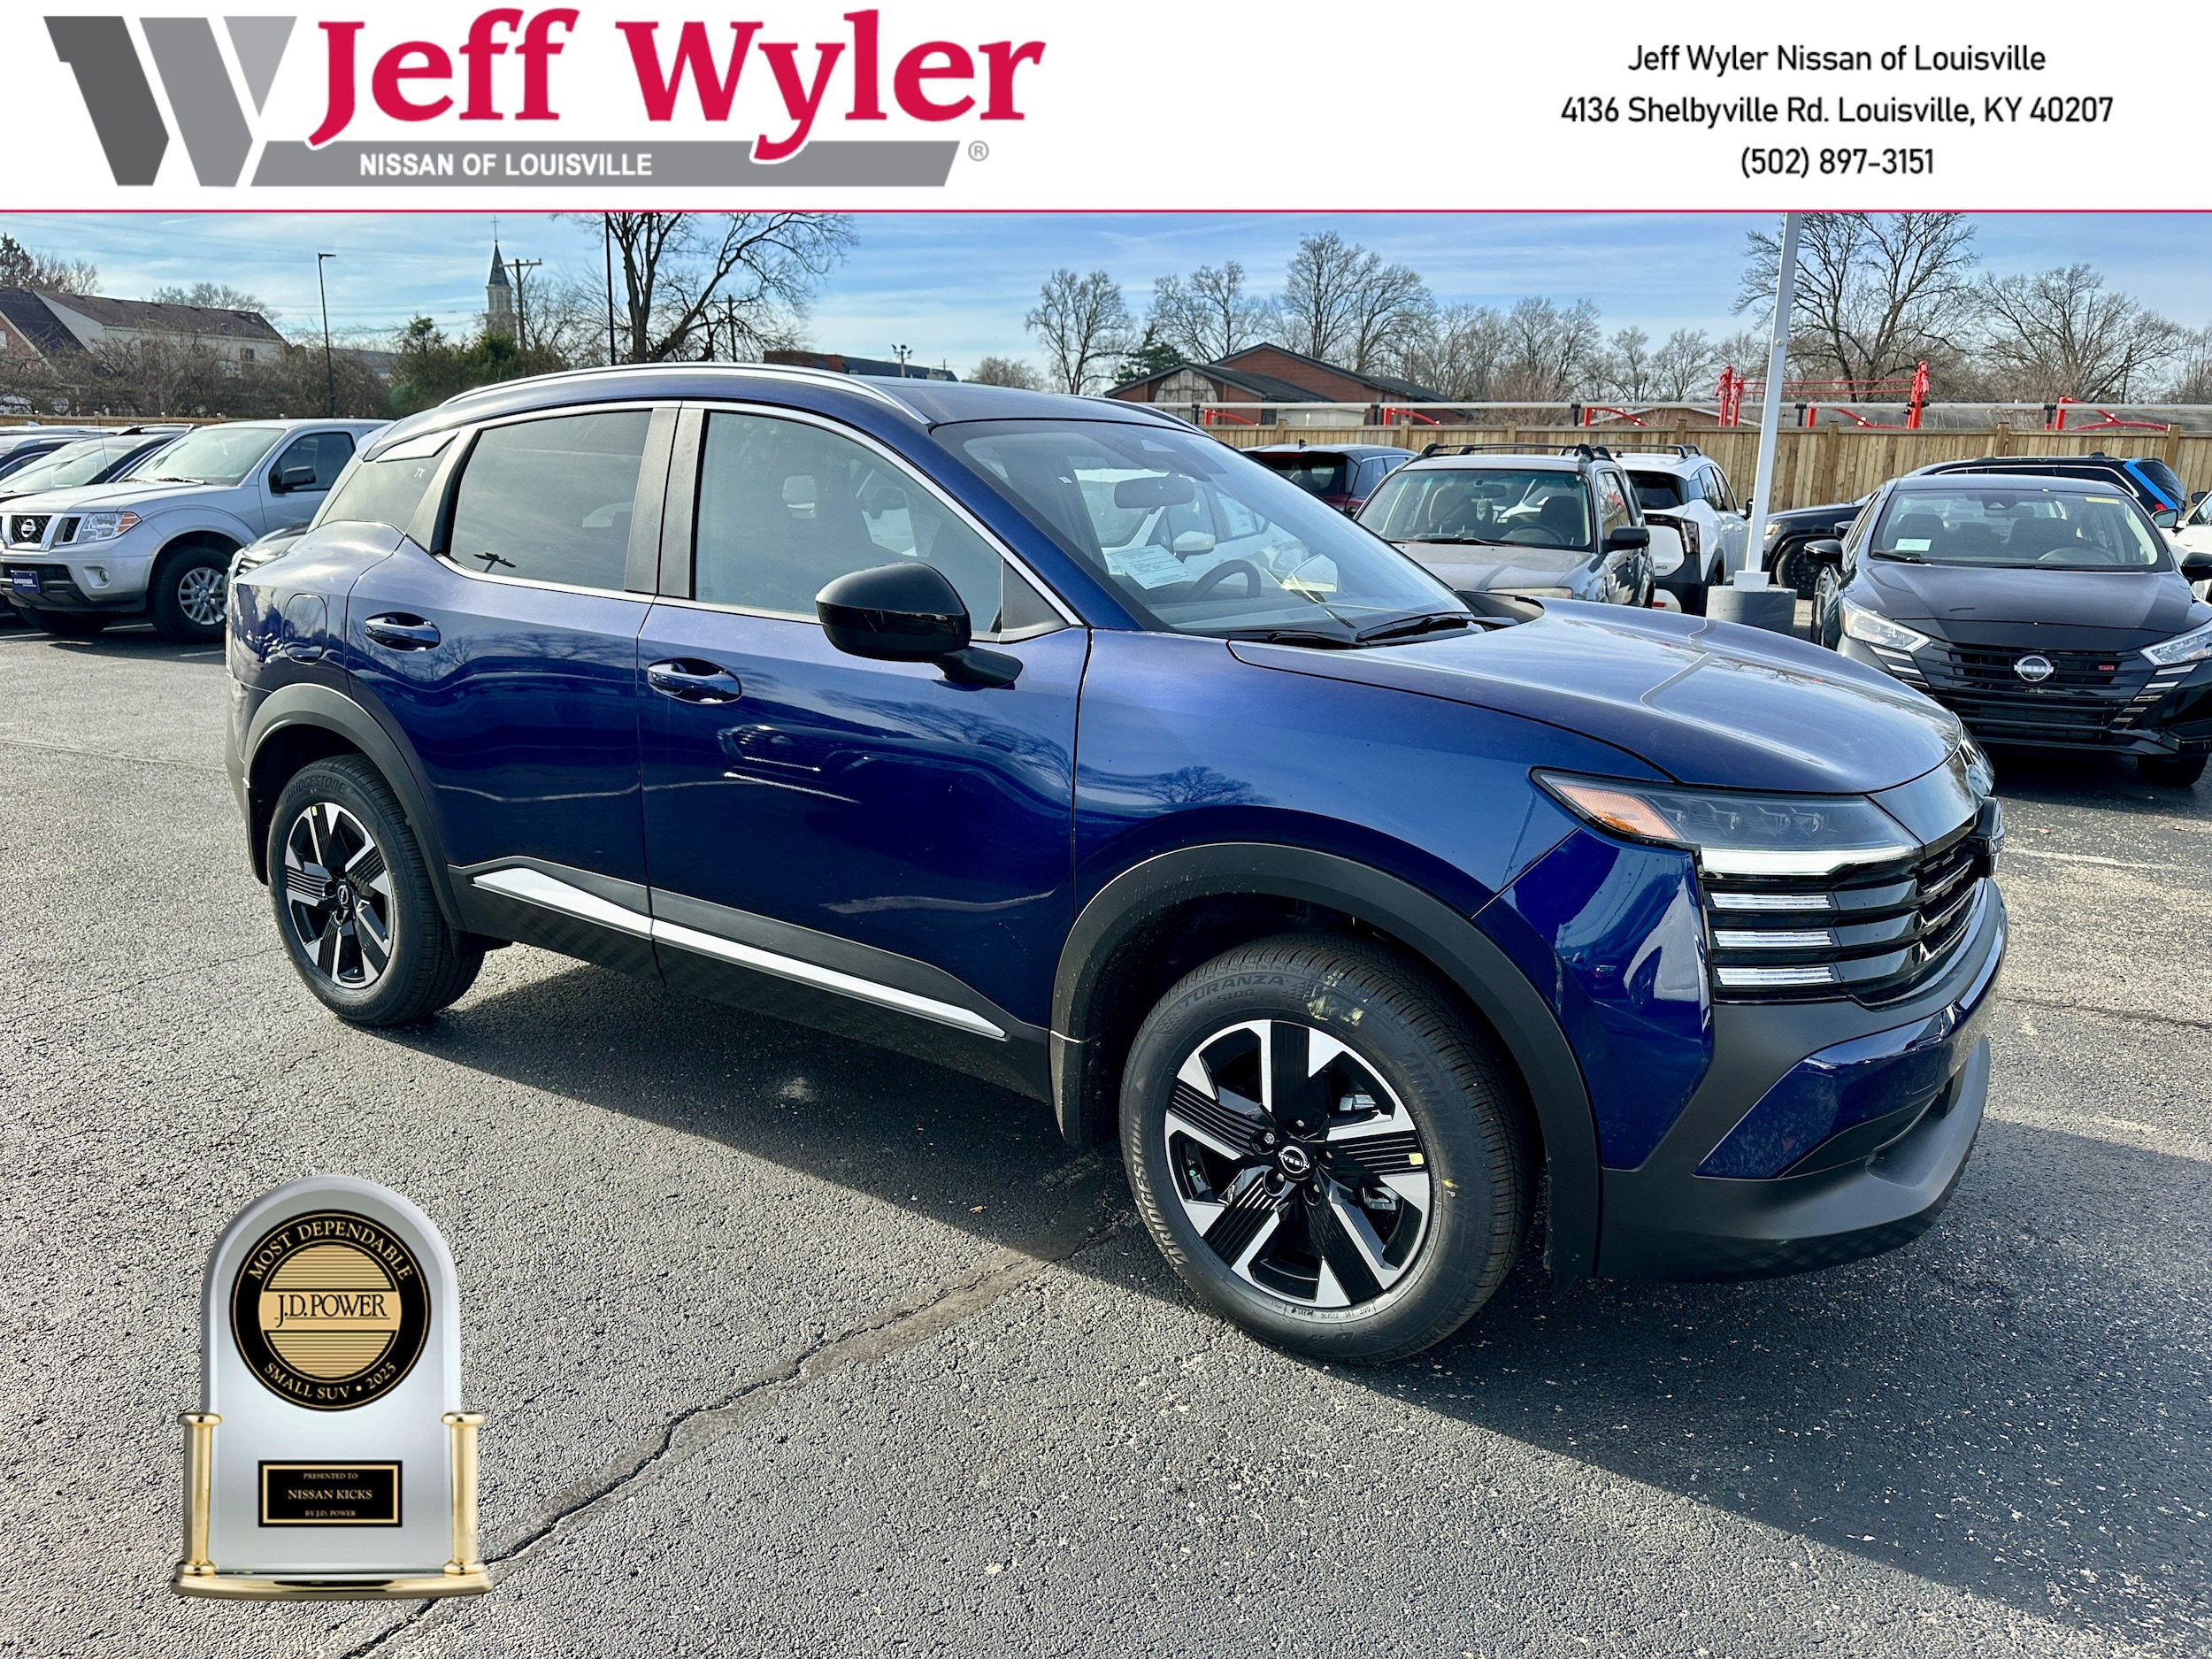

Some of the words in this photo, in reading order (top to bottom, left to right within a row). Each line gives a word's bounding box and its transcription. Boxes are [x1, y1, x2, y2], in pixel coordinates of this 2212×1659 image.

[2014, 664, 2054, 673] NISSAN
[286, 775, 346, 803] BRIDGESTONE
[1179, 975, 1284, 1009] TURANZA
[1128, 1108, 1191, 1266] BRIDGESTONE
